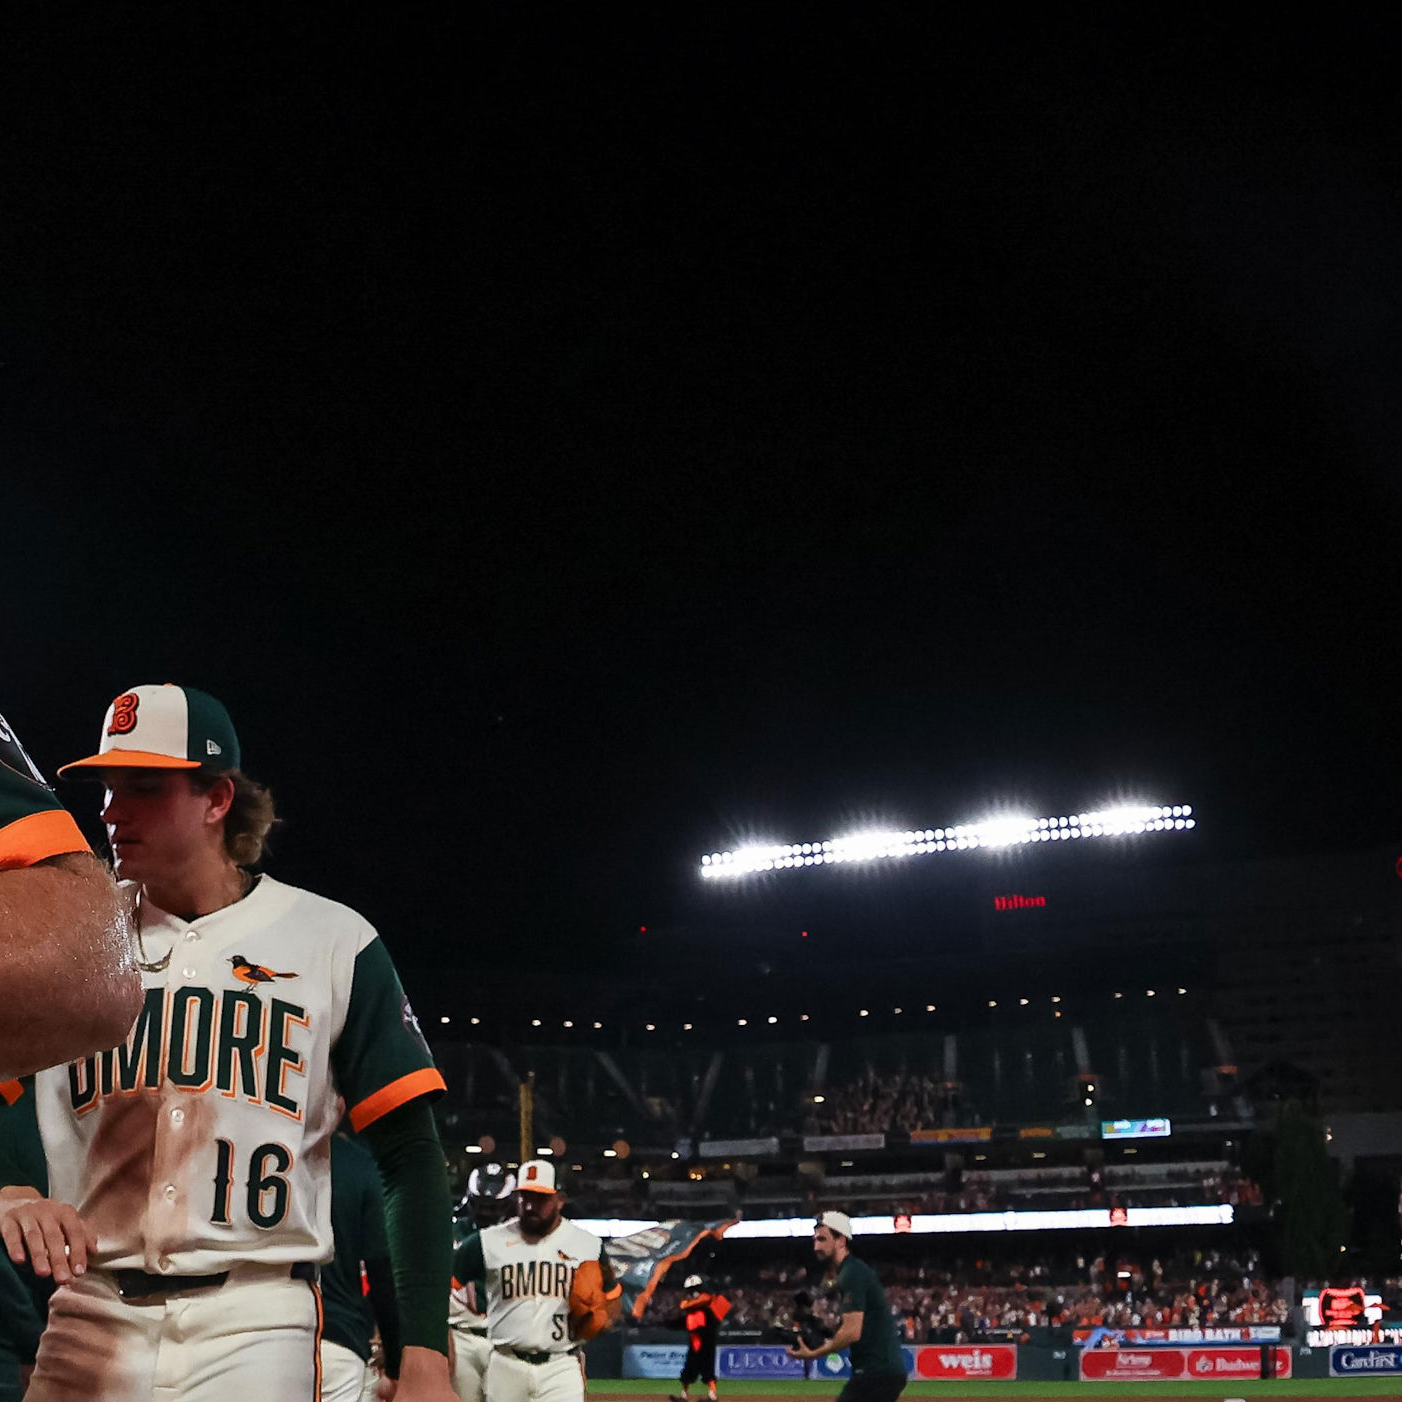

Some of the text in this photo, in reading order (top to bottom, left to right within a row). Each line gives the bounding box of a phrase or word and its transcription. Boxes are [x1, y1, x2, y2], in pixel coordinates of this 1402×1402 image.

[106, 692, 139, 736] B
[994, 894, 1046, 911] Hilton
[209, 1134, 295, 1231] 16
[938, 1349, 993, 1369] weis
